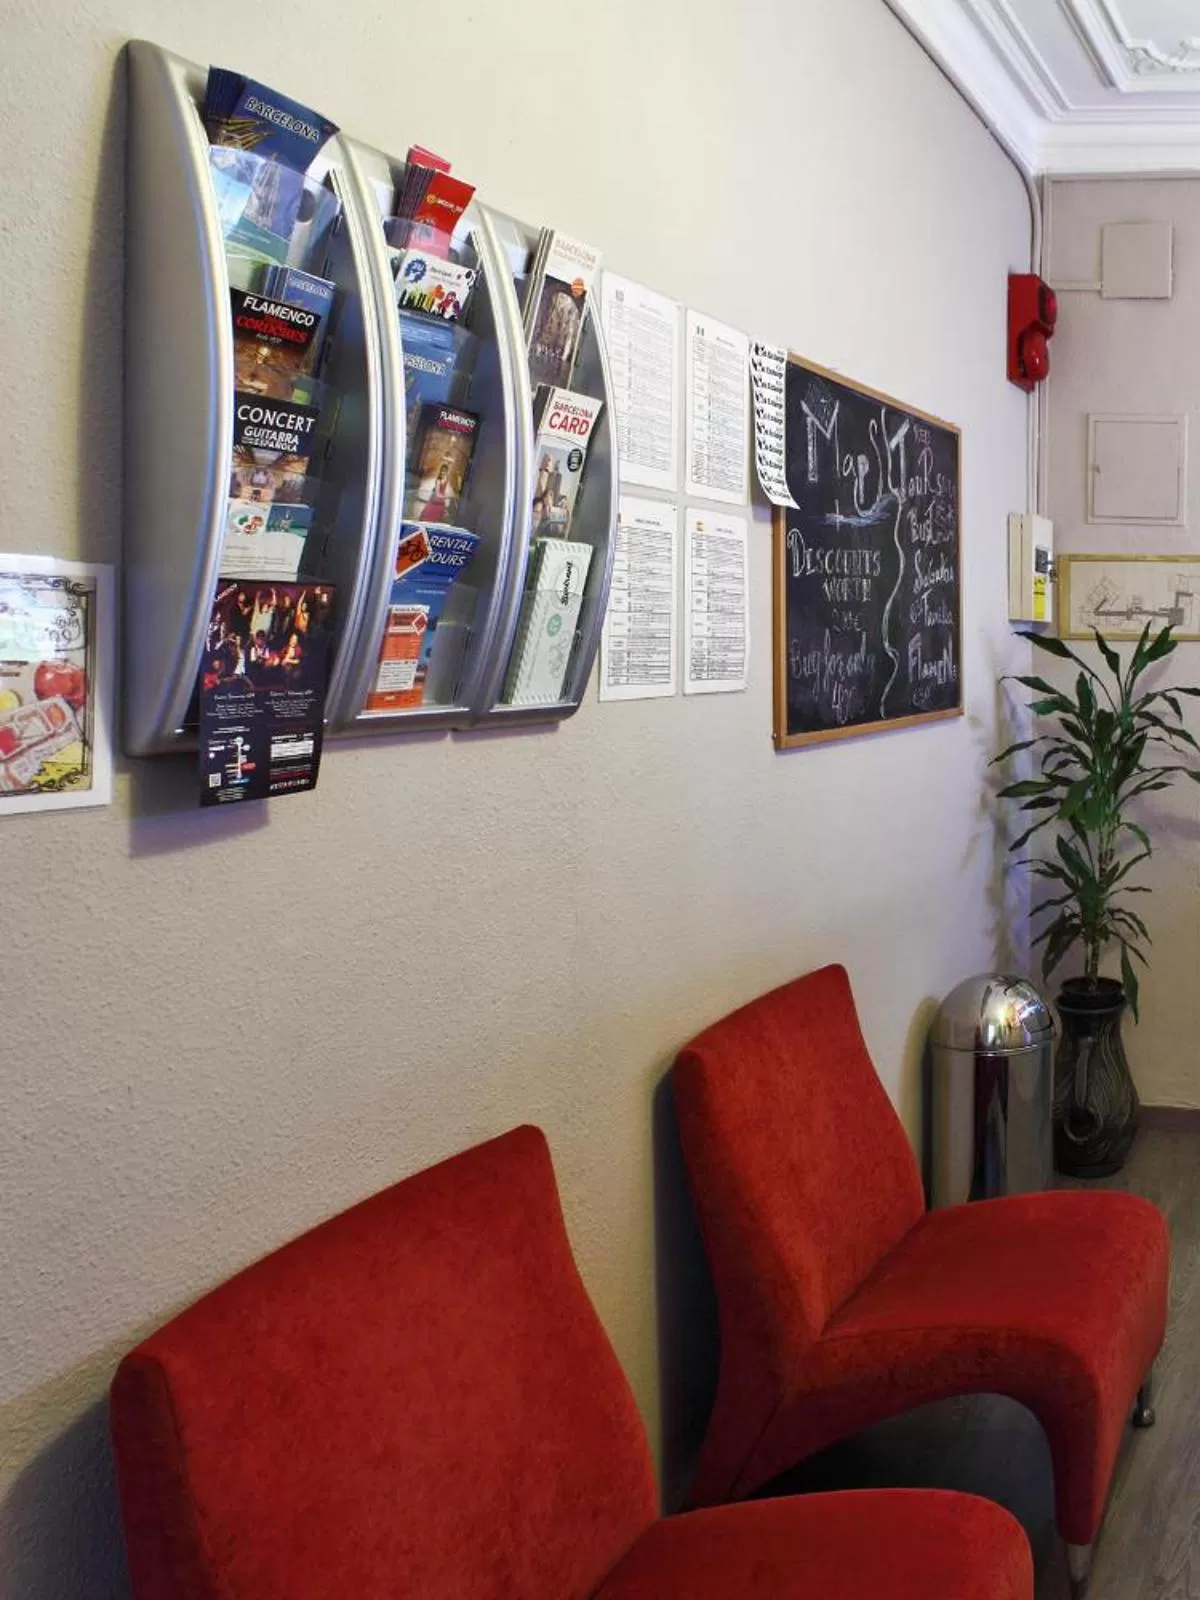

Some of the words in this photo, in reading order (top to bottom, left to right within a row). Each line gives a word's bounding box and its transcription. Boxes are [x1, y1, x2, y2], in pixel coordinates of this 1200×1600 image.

[245, 97, 320, 143] BARCELONA
[243, 296, 315, 327] FLAMENCO
[237, 404, 315, 433] CONCERT
[548, 411, 590, 436] CARD
[244, 425, 300, 445] GUITARRA
[429, 535, 474, 553] RENTAL
[425, 551, 467, 566] TOURS
